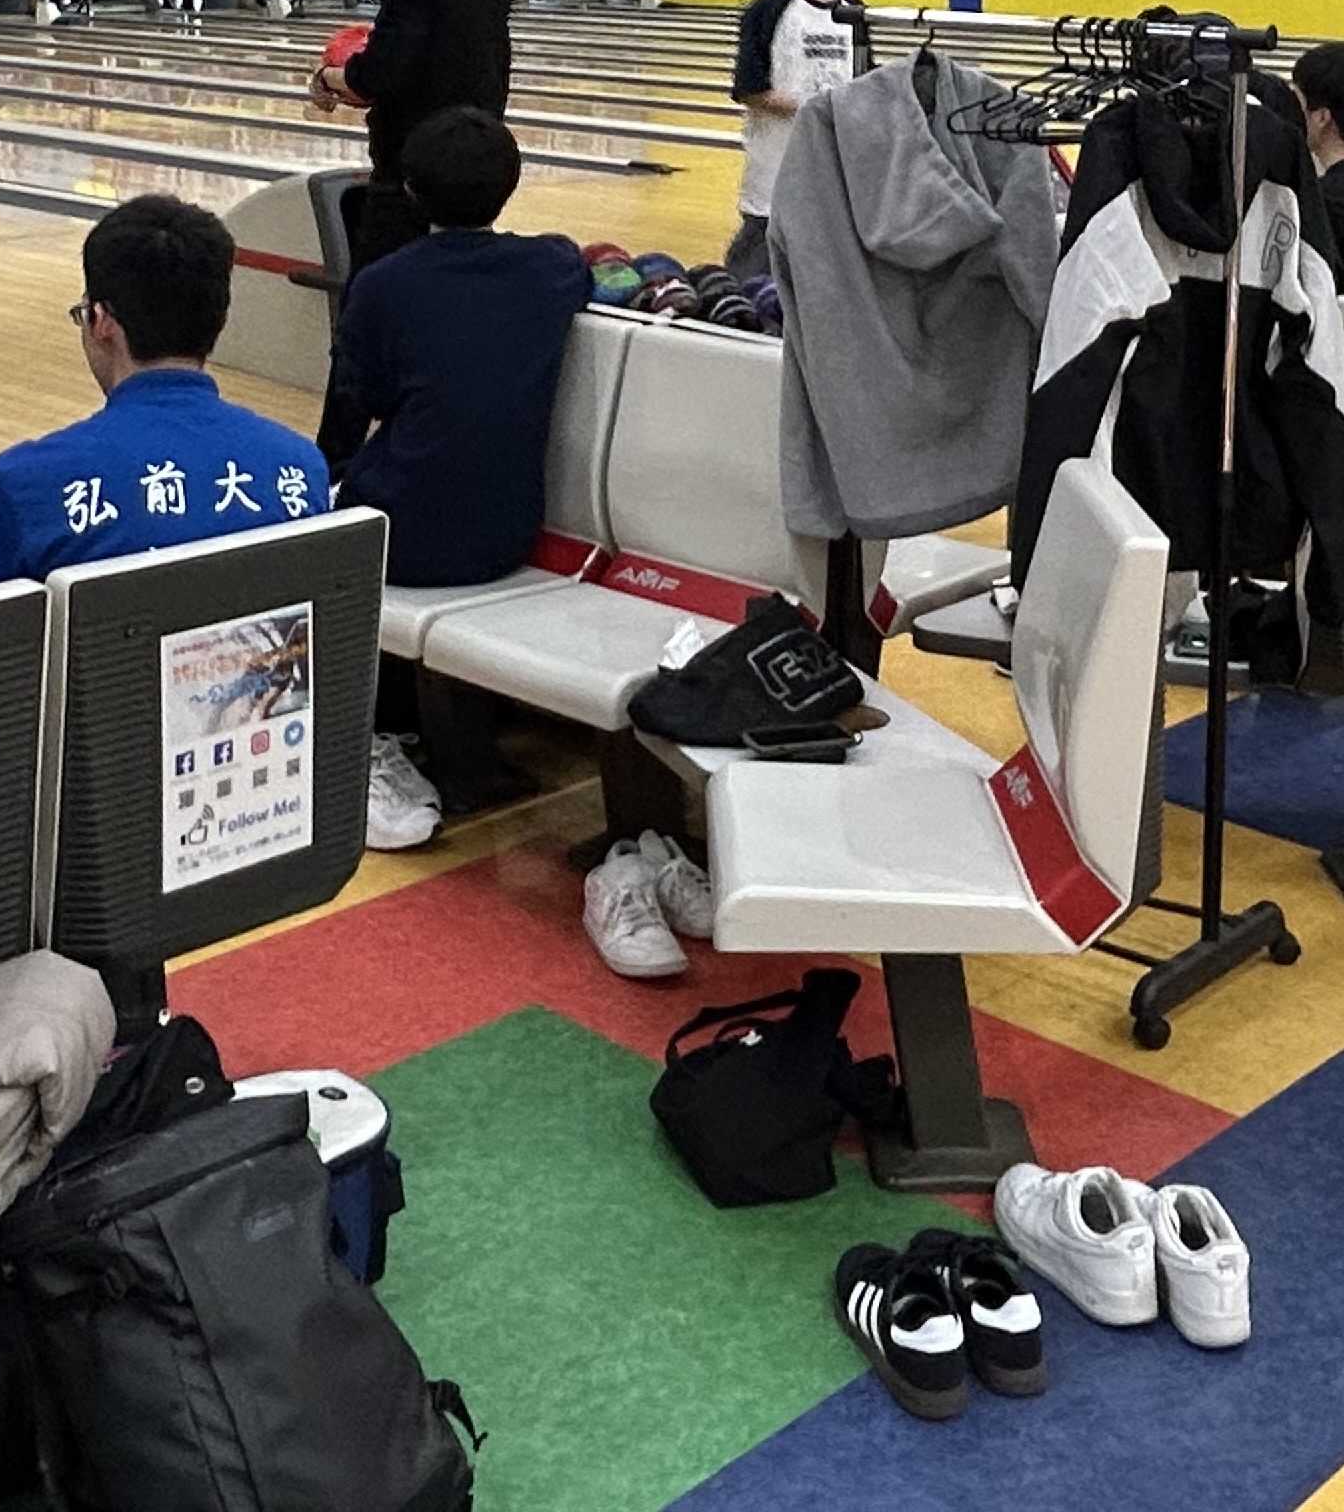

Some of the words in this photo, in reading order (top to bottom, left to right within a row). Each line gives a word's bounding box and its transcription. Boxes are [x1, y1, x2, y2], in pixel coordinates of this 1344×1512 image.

[63, 461, 308, 534] 弘前大学
[614, 566, 681, 591] AMF
[219, 805, 270, 836] Follow
[272, 795, 302, 818] Me!
